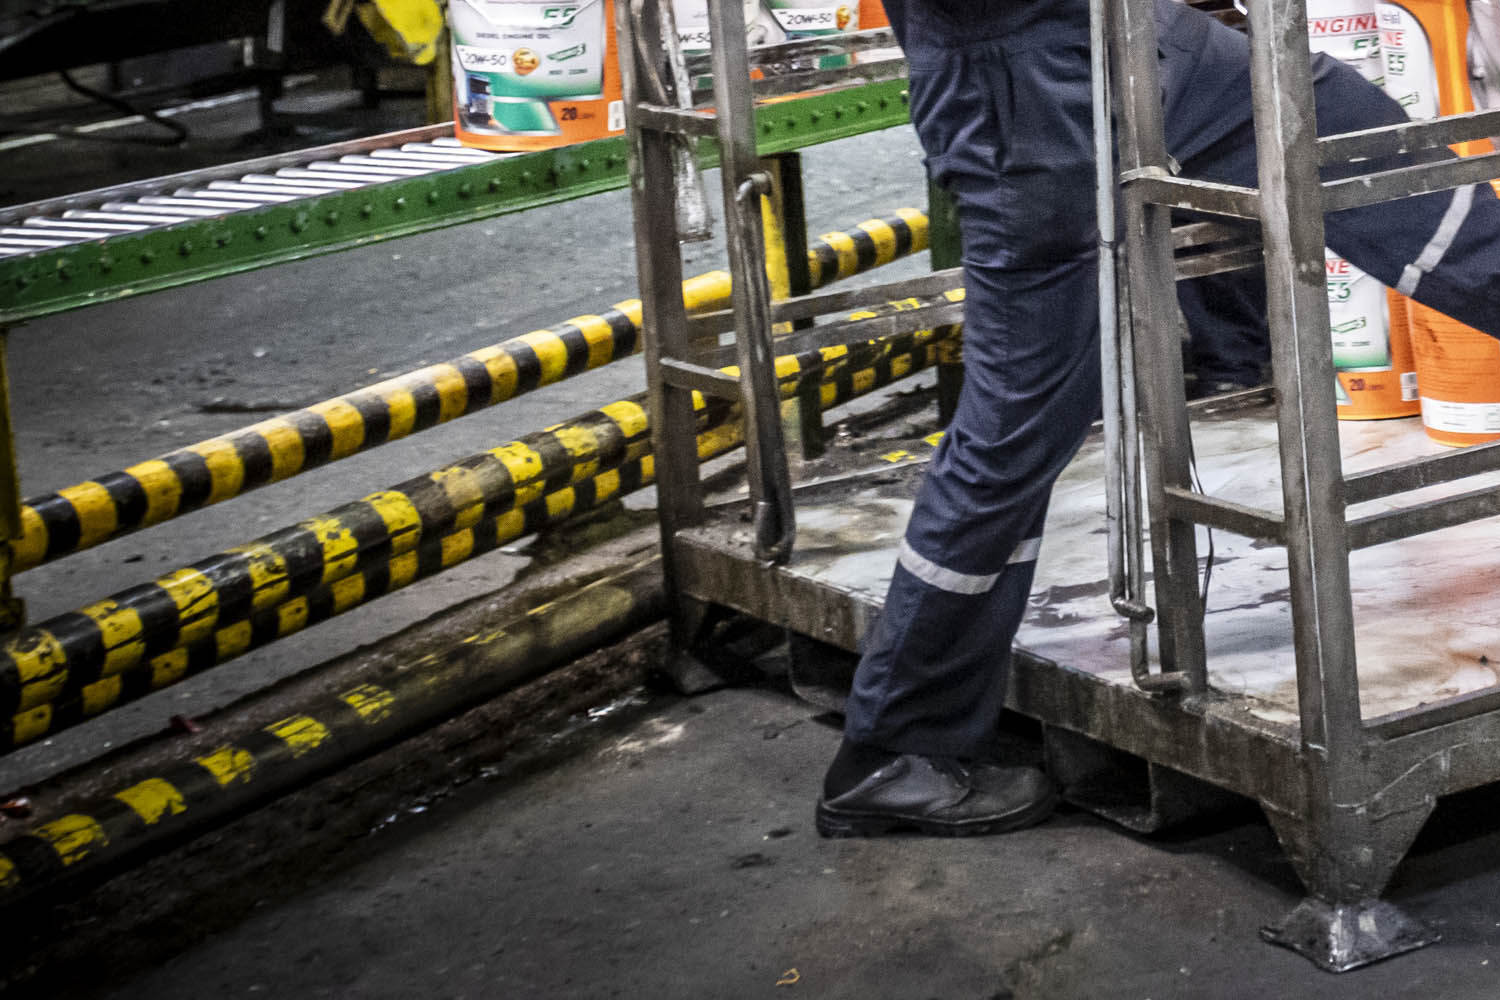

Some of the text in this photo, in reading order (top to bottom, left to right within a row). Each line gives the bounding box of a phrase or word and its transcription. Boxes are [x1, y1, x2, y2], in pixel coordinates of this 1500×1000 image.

[786, 12, 832, 25] 20W-50
[1308, 14, 1378, 34] NGINE
[465, 53, 507, 66] 20W-50
[561, 106, 577, 121] 20
